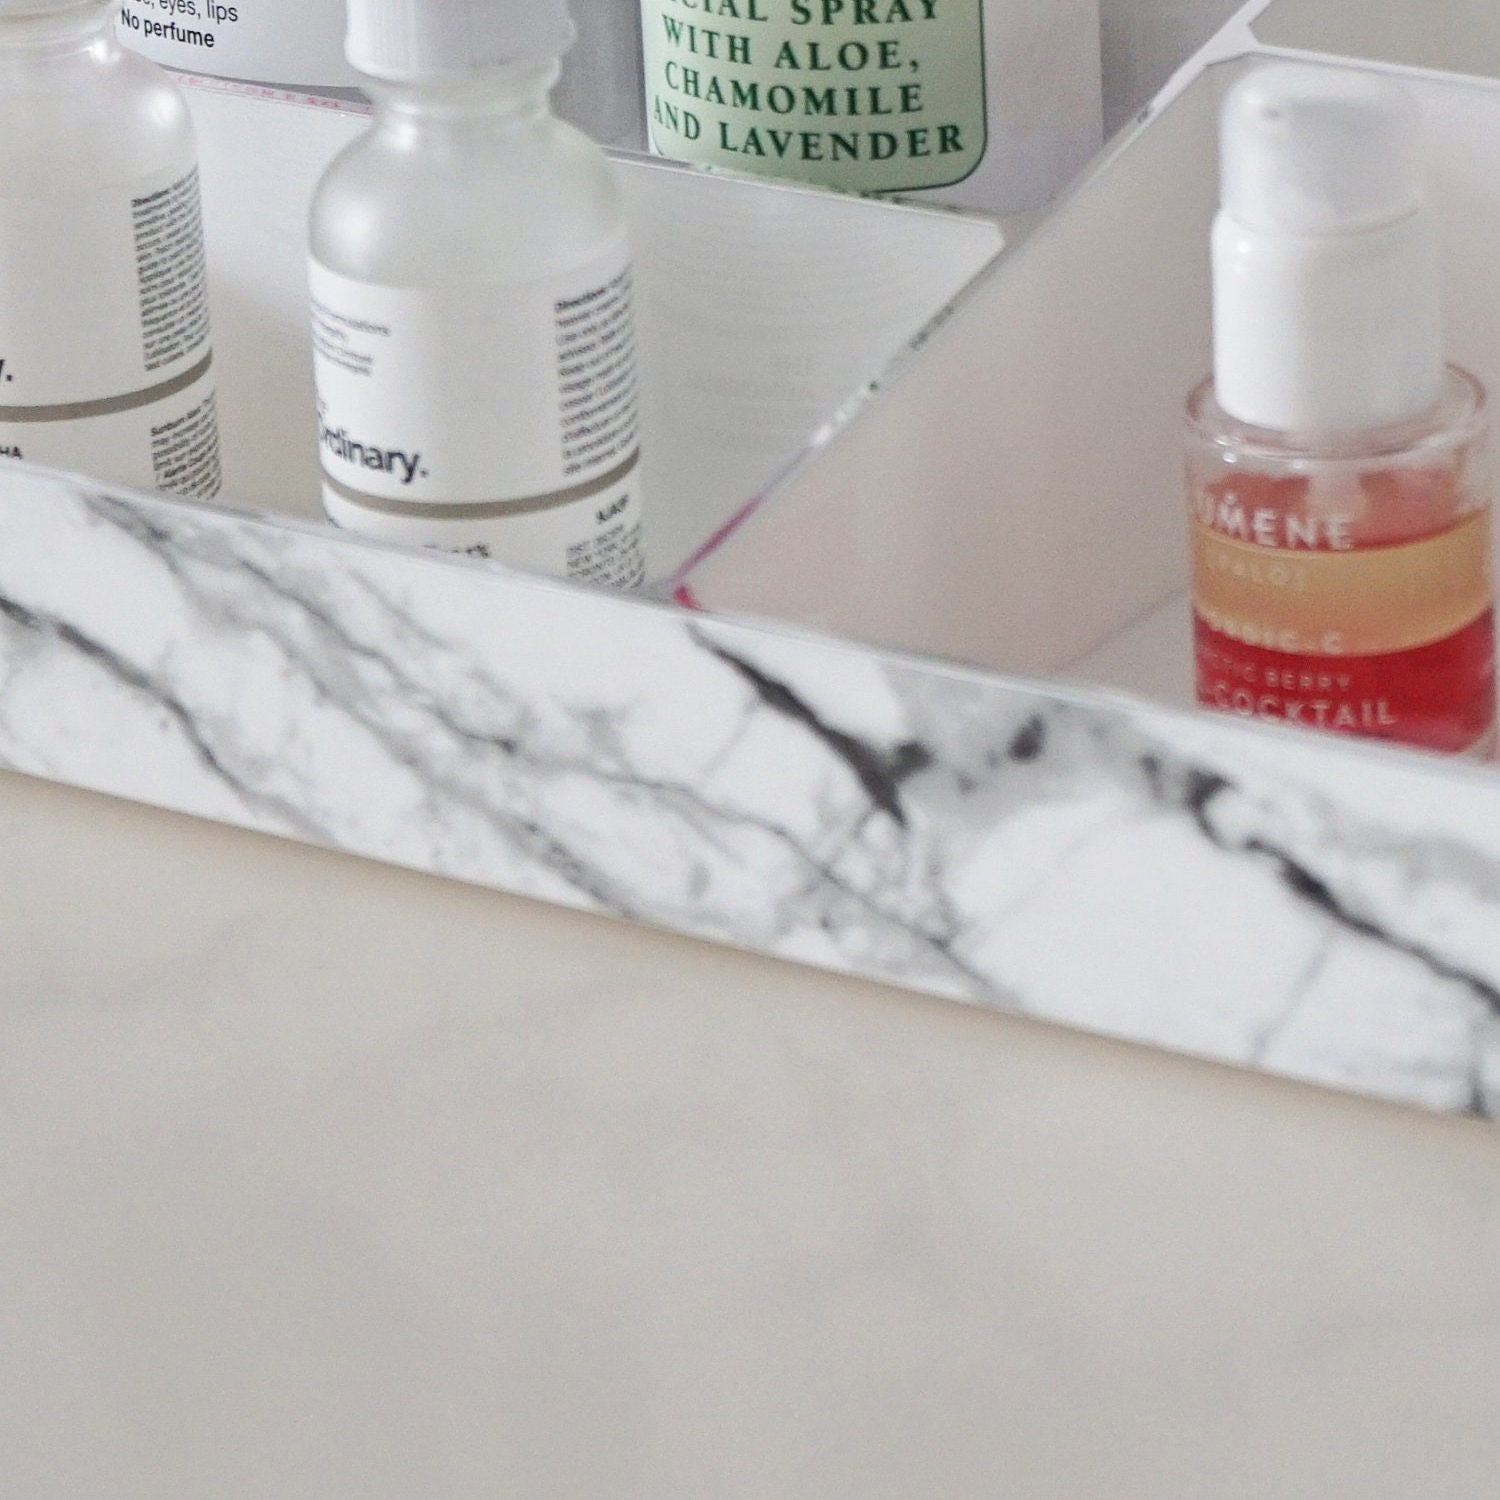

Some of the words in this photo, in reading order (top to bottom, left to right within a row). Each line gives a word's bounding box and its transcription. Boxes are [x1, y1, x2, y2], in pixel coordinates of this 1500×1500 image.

[121, 7, 140, 31] No
[144, 17, 216, 49] perfume
[206, 0, 239, 25] lips
[661, 13, 753, 66] WITH
[774, 39, 920, 74] ALOE,
[664, 61, 924, 117] CHAMOMILE
[653, 94, 701, 141] AND
[718, 121, 965, 162] LAVENDER
[320, 425, 430, 485] rdinary.
